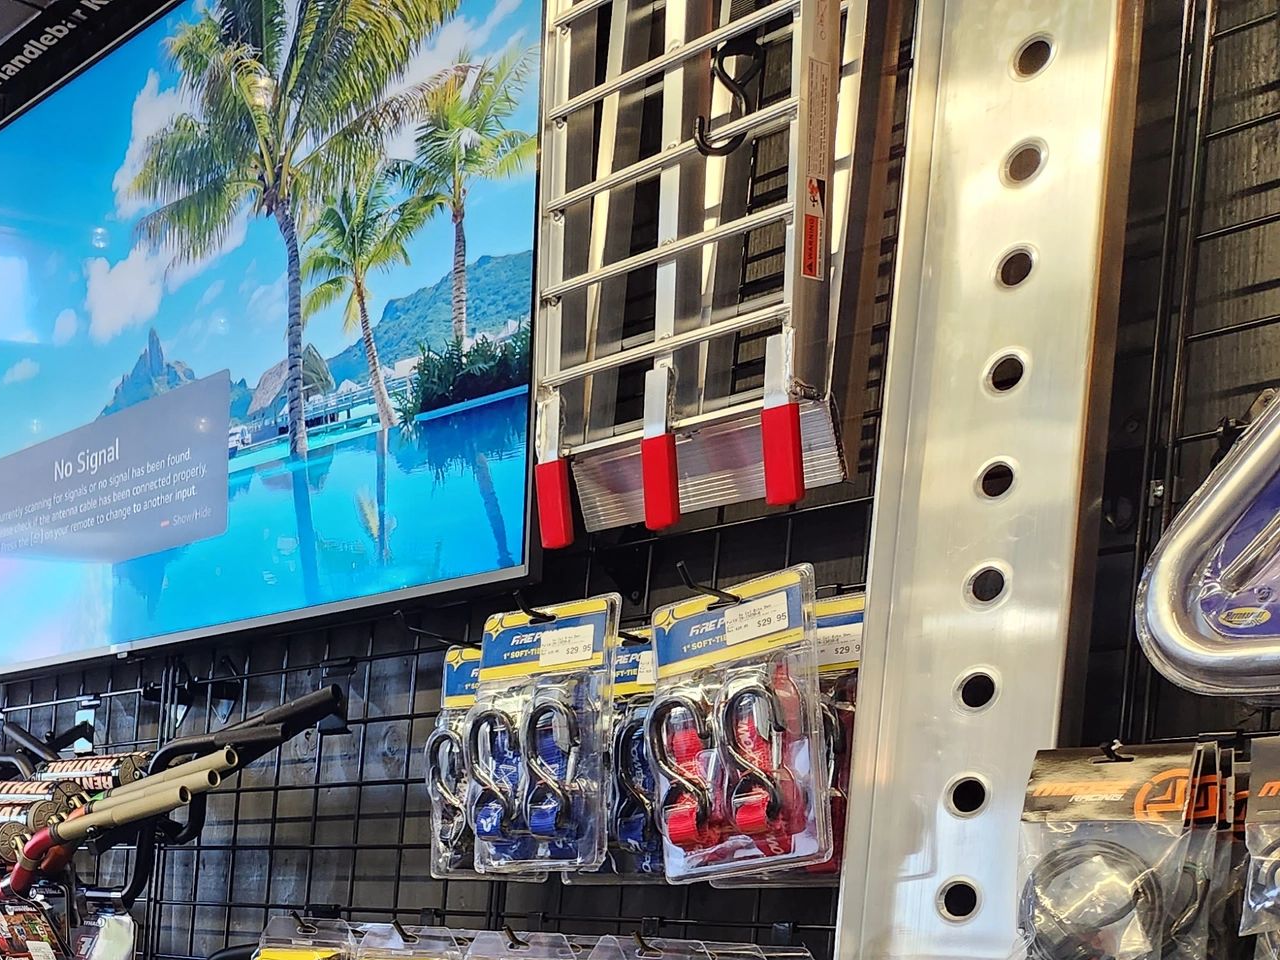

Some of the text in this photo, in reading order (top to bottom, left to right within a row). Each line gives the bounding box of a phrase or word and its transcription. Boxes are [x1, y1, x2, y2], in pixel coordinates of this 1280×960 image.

[54, 438, 119, 482] No Signal
[24, 498, 52, 515] scanning
[53, 492, 63, 505] for
[64, 485, 87, 502] signals
[88, 482, 97, 492] or
[98, 479, 108, 490] no
[109, 468, 130, 487] signal
[131, 465, 144, 479] has
[146, 460, 165, 474] been
[39, 515, 50, 526] the
[51, 505, 78, 522] antenna
[80, 498, 97, 513] cable
[98, 493, 111, 506] has
[112, 487, 131, 501] been
[131, 476, 171, 496] connected
[172, 462, 208, 486] properly.
[53, 524, 69, 541] your
[70, 517, 95, 533] remote
[96, 513, 105, 525] to
[105, 504, 131, 521] change
[133, 503, 141, 514] to
[143, 492, 173, 511] another
[172, 505, 212, 527] Show/Hide
[834, 644, 861, 655] $29.9
